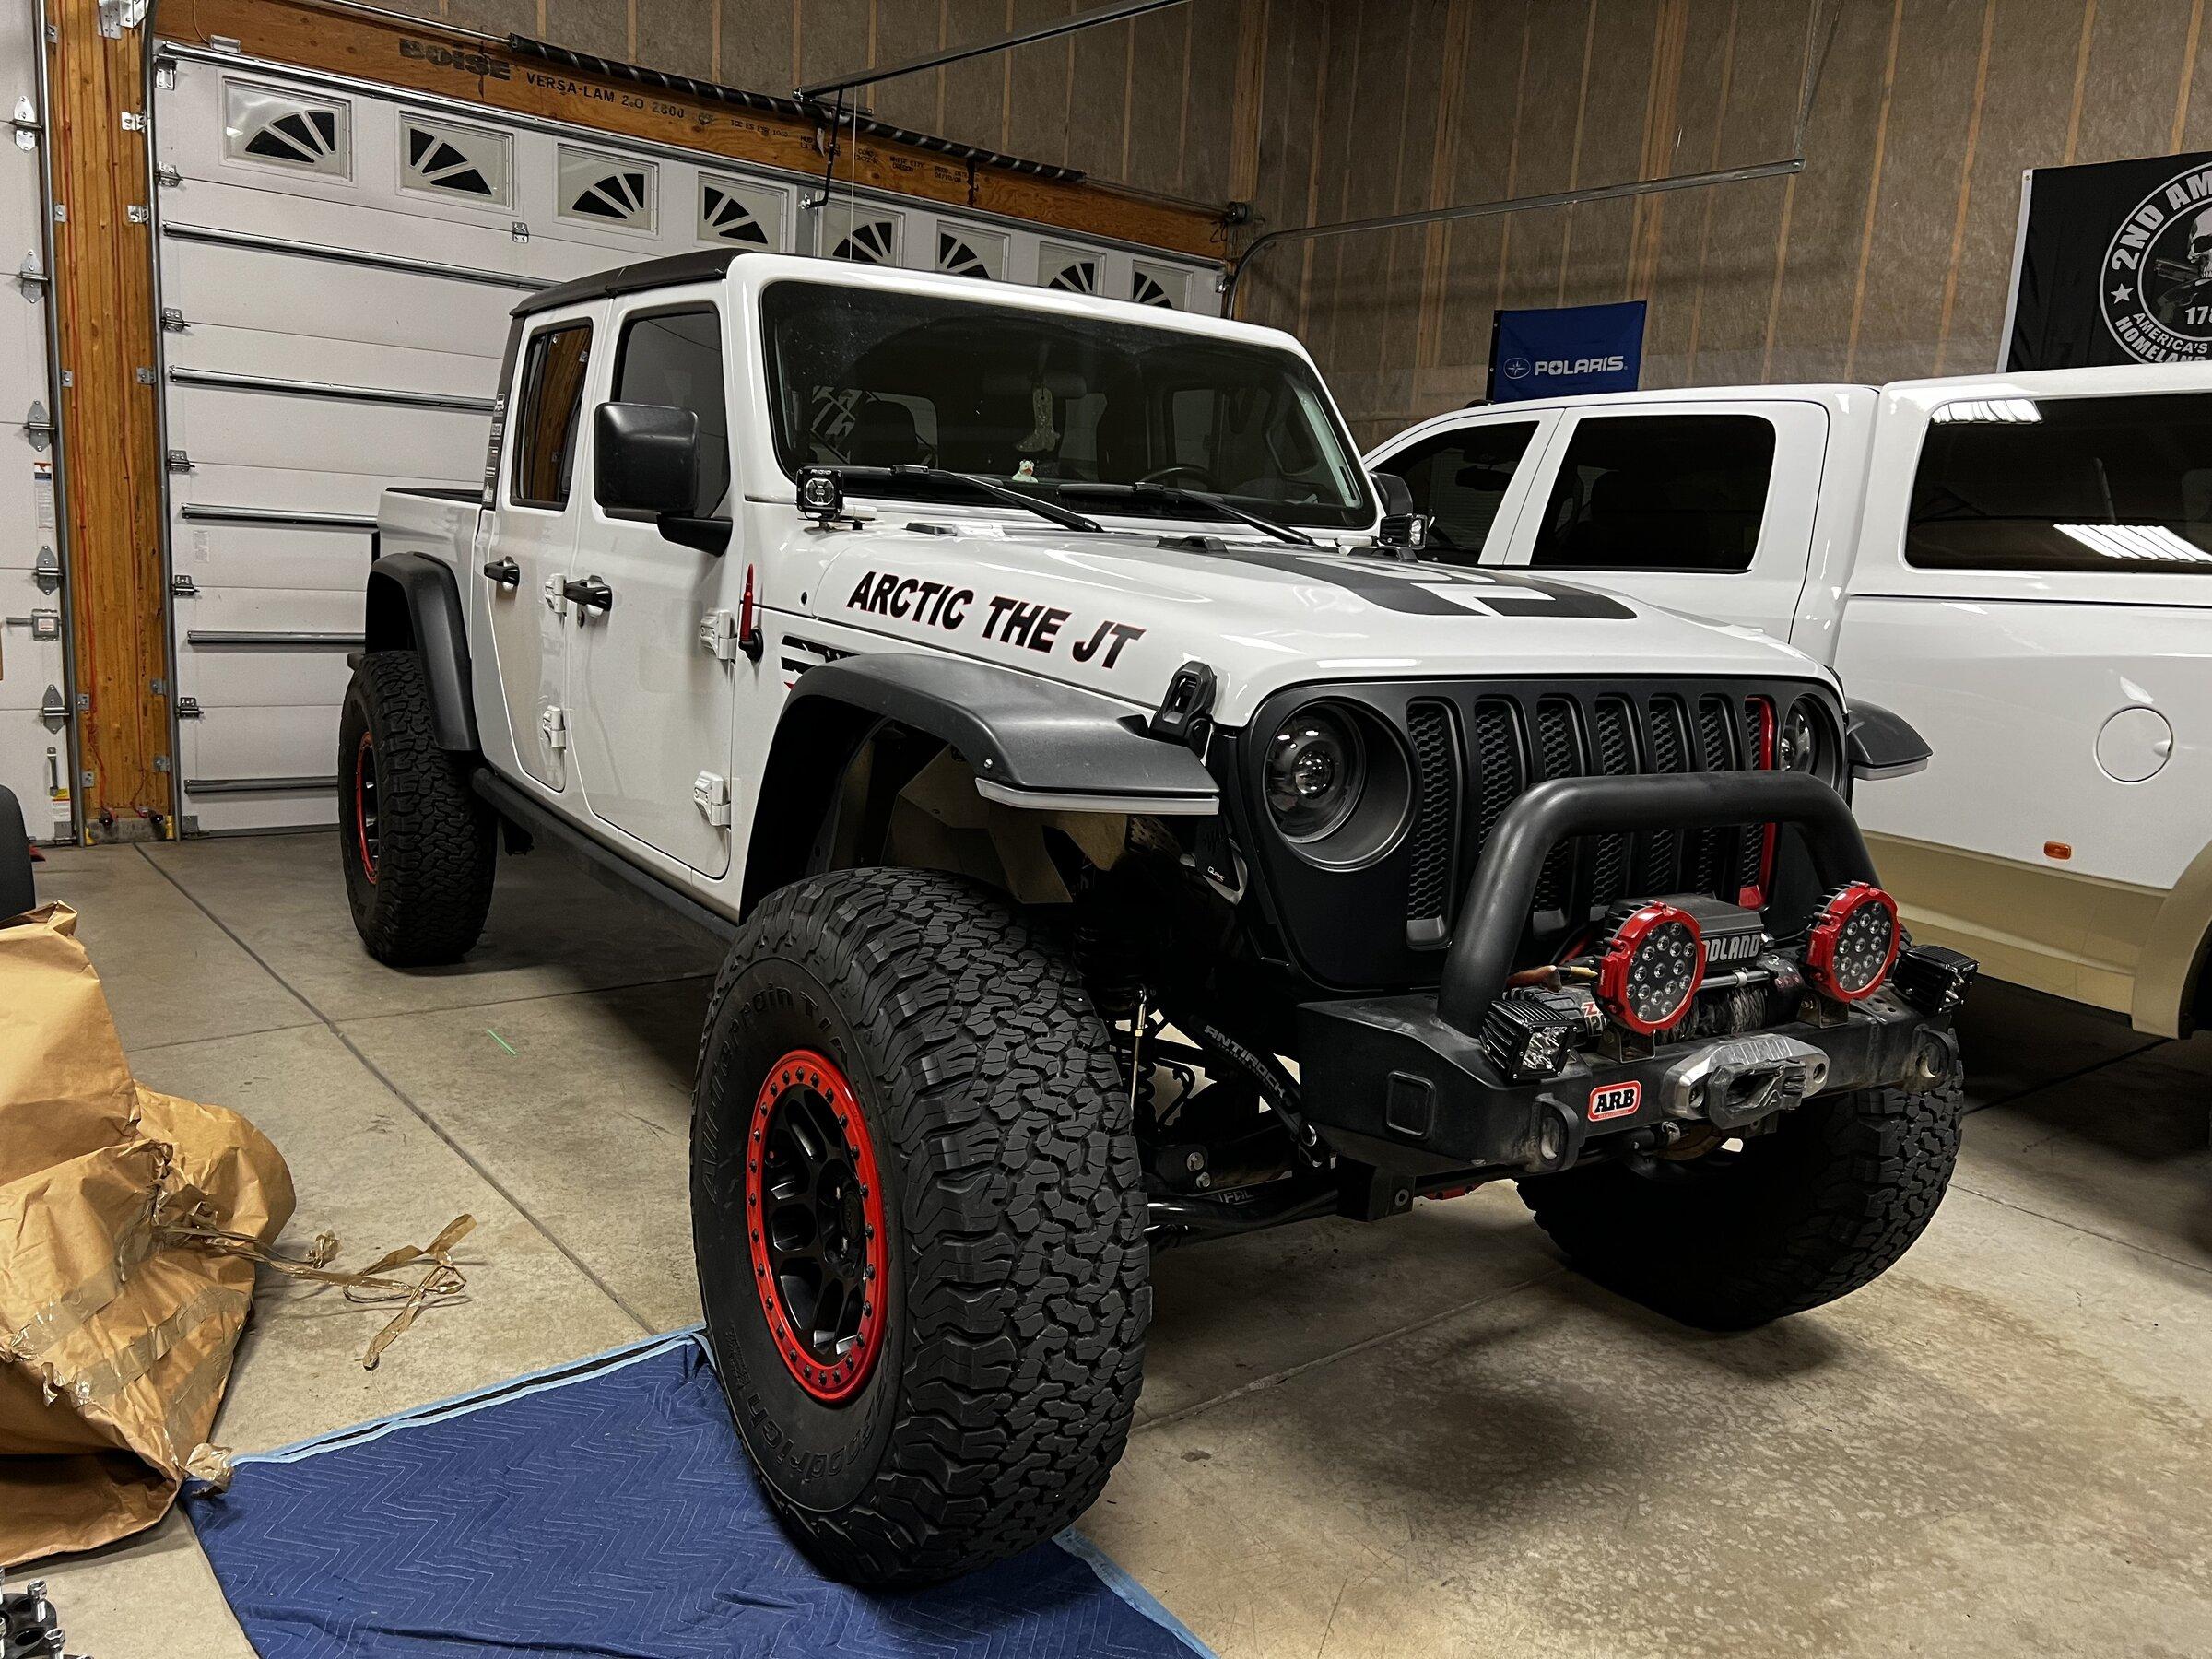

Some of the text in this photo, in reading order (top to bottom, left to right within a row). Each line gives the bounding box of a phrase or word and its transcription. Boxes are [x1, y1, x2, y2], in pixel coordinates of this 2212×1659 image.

[526, 71, 616, 103] VERSA-LAM
[2111, 204, 2165, 270] 2ND
[2132, 312, 2208, 354] AMERICA'S
[1535, 355, 1624, 376] POLARIS
[845, 571, 1147, 670] ARCTIC THE JT
[1204, 1024, 1287, 1099] ANTIROCK
[1594, 1088, 1635, 1113] ARB
